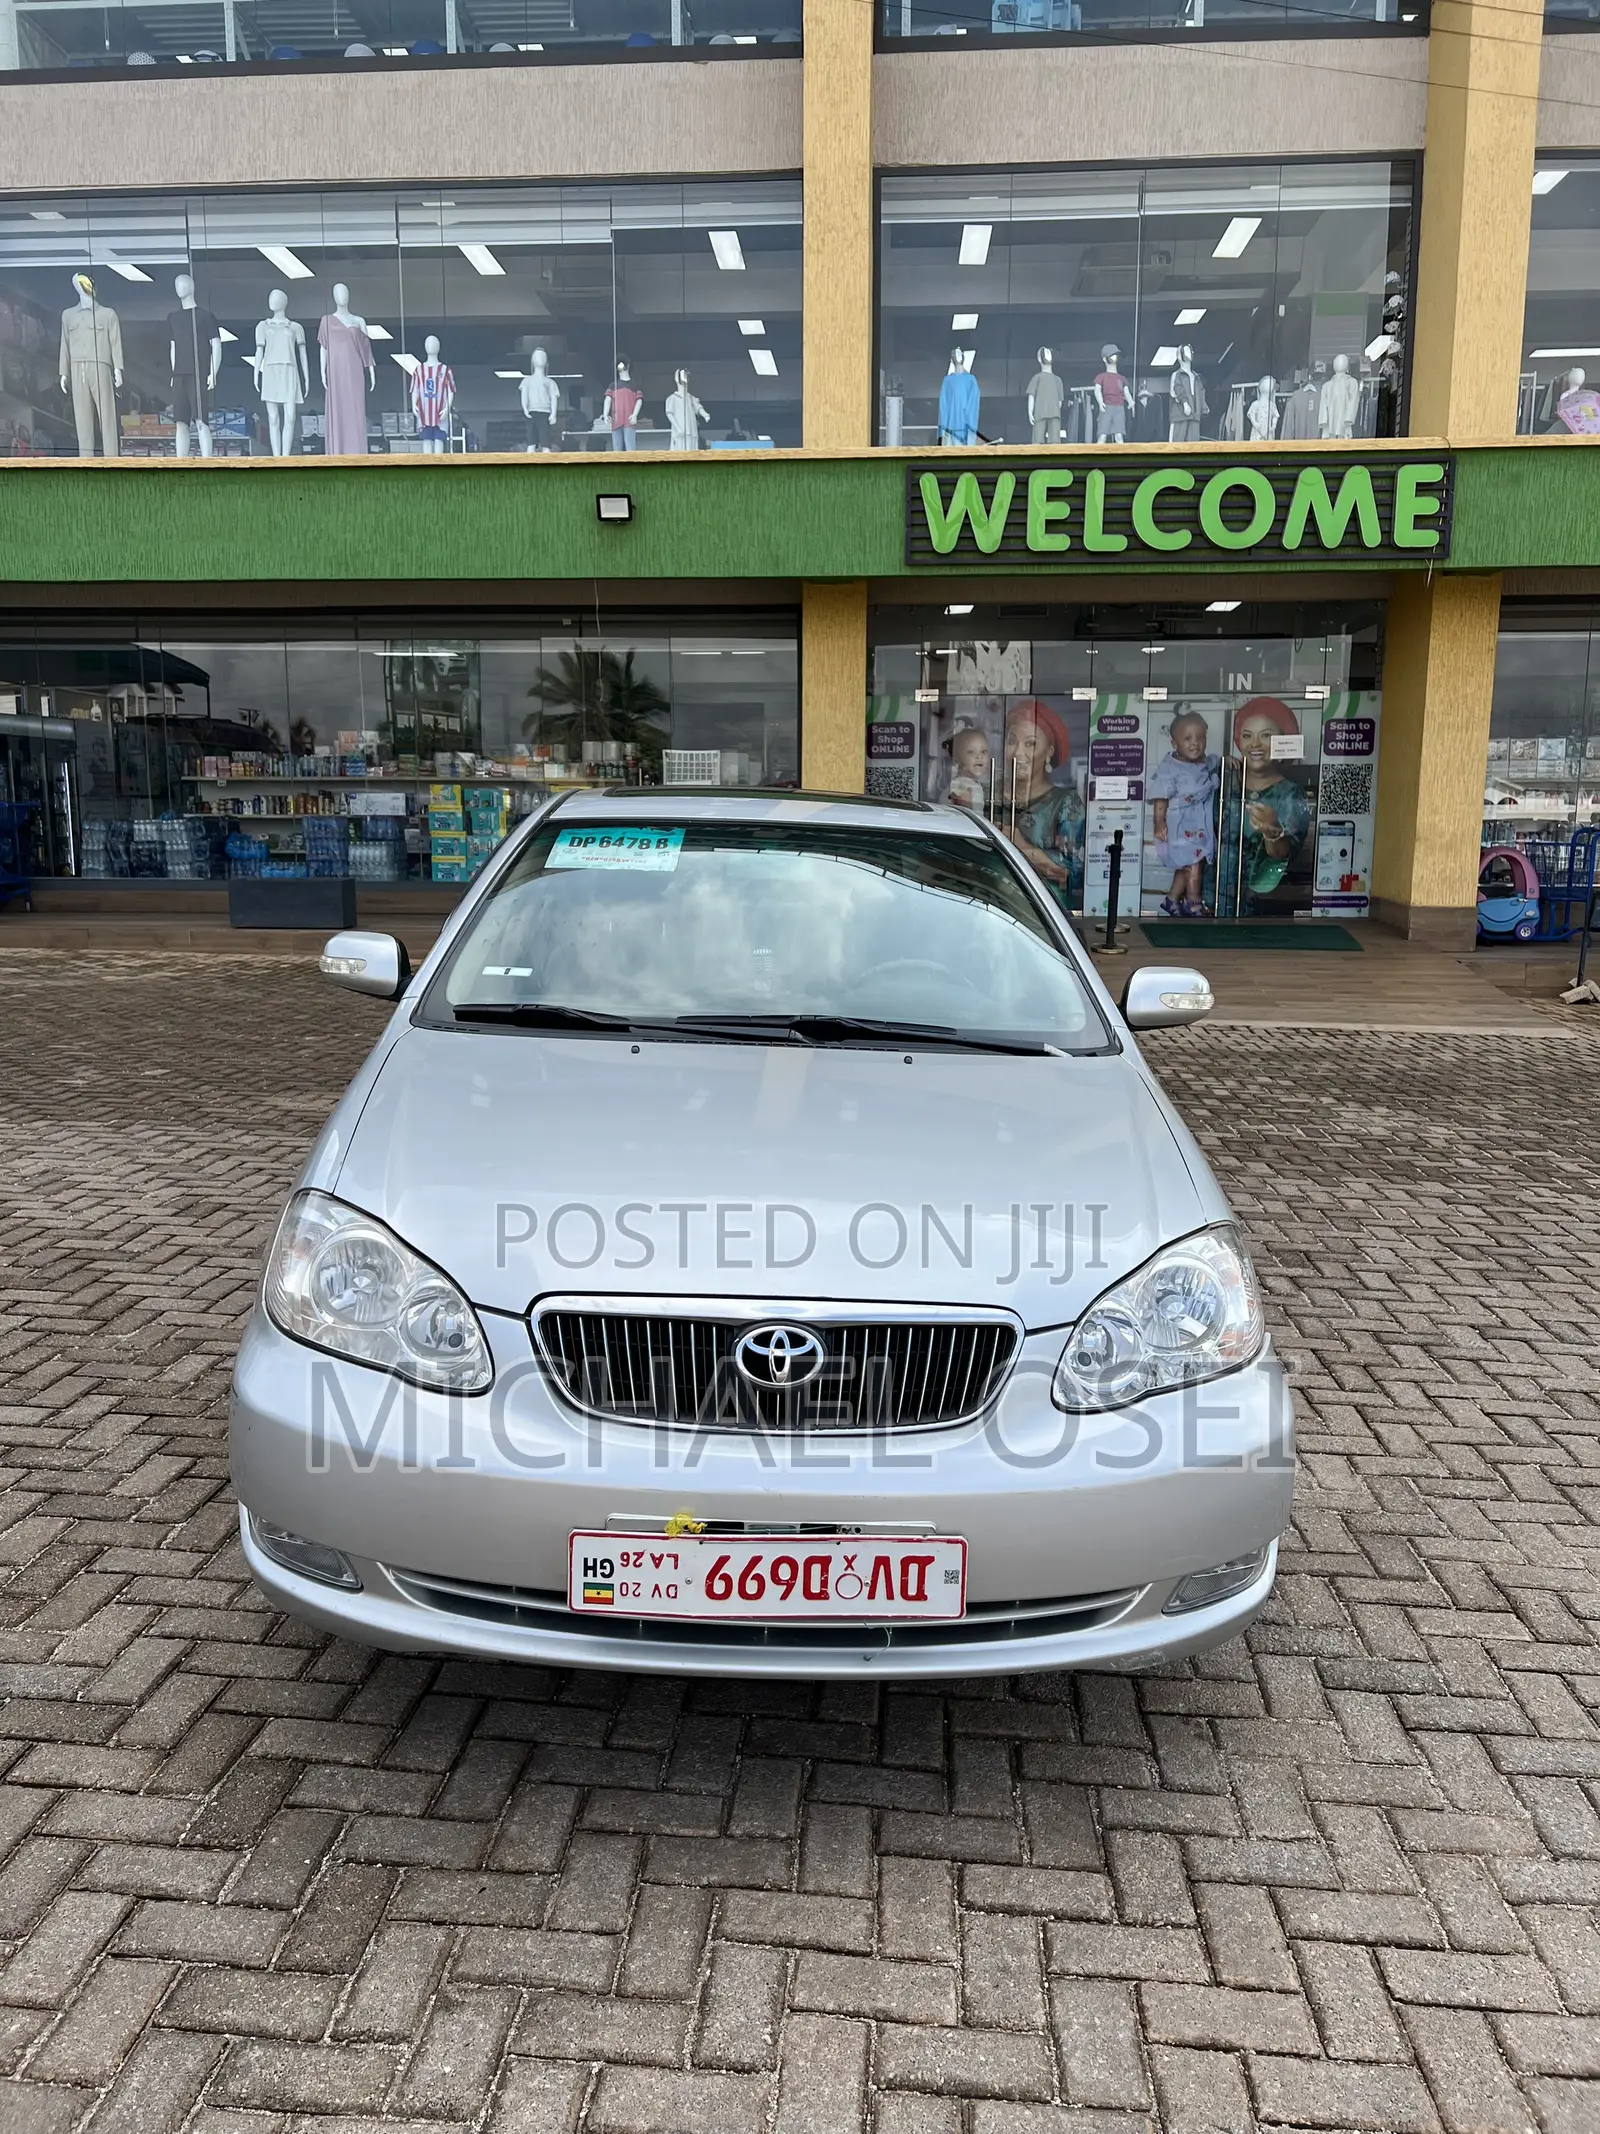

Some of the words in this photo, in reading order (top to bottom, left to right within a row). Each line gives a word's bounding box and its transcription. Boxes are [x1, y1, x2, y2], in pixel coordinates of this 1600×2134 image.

[918, 465, 1444, 554] WELCOME
[1228, 673, 1252, 690] IN
[1102, 717, 1136, 725] Working
[1330, 722, 1356, 730] Scan
[1359, 722, 1370, 730] to
[872, 726, 896, 734] Scan
[900, 726, 910, 734] to
[1336, 732, 1363, 741] Shop
[877, 735, 904, 745] Shop
[1328, 742, 1370, 750] ONLINE
[871, 745, 910, 753] ONLINE
[569, 836, 596, 848] DP
[599, 836, 651, 850] 6478
[655, 837, 669, 849] B
[620, 1551, 645, 1568] 26
[650, 1553, 679, 1570] LA
[583, 1557, 615, 1579] GH
[704, 1555, 832, 1601] D699
[866, 1555, 935, 1601] DV
[620, 1582, 642, 1597] 20
[651, 1583, 678, 1599] DV
